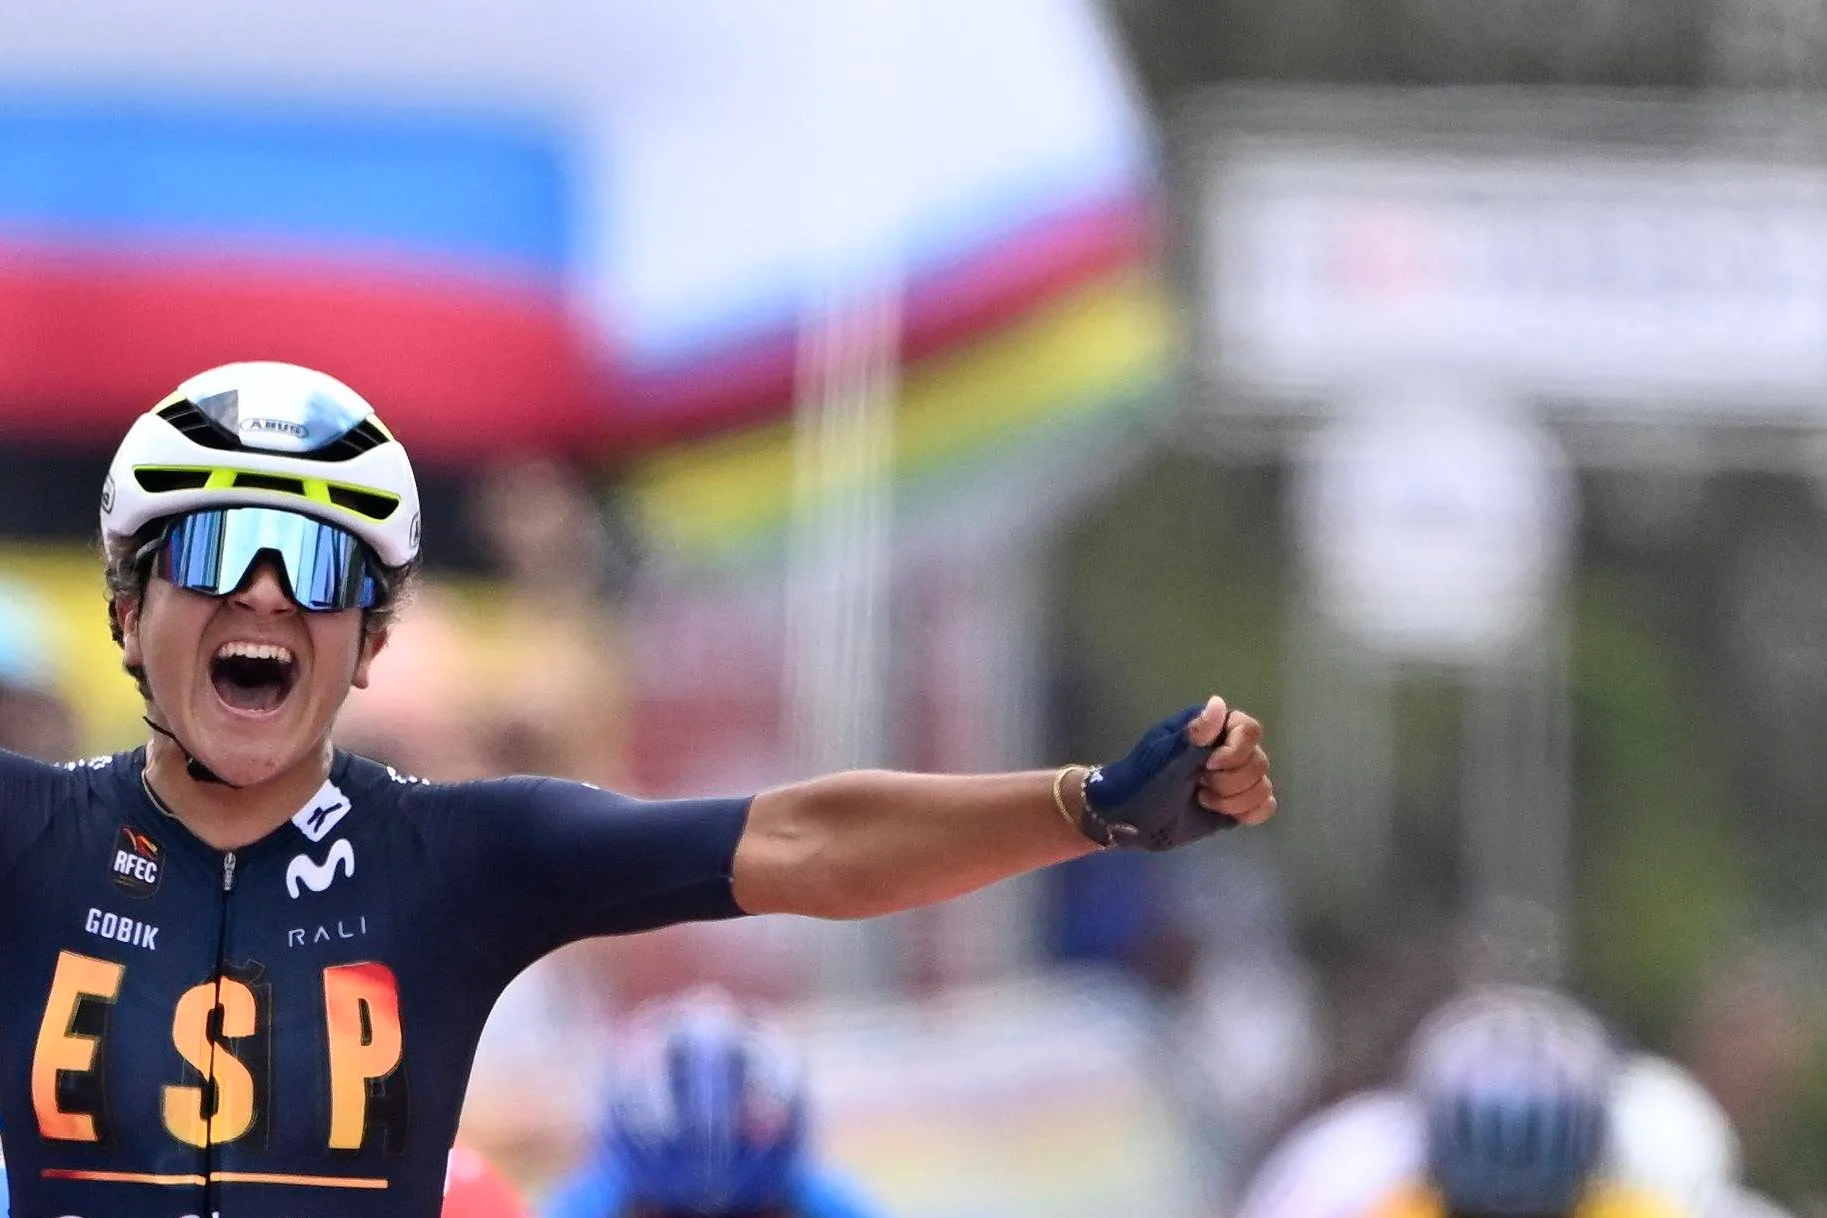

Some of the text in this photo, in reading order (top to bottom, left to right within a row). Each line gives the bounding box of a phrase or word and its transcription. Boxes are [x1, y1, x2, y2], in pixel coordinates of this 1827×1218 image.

[114, 849, 158, 884] RFEC
[85, 908, 159, 950] GOBIK
[288, 916, 366, 948] RALI
[31, 949, 403, 1150] ESP
